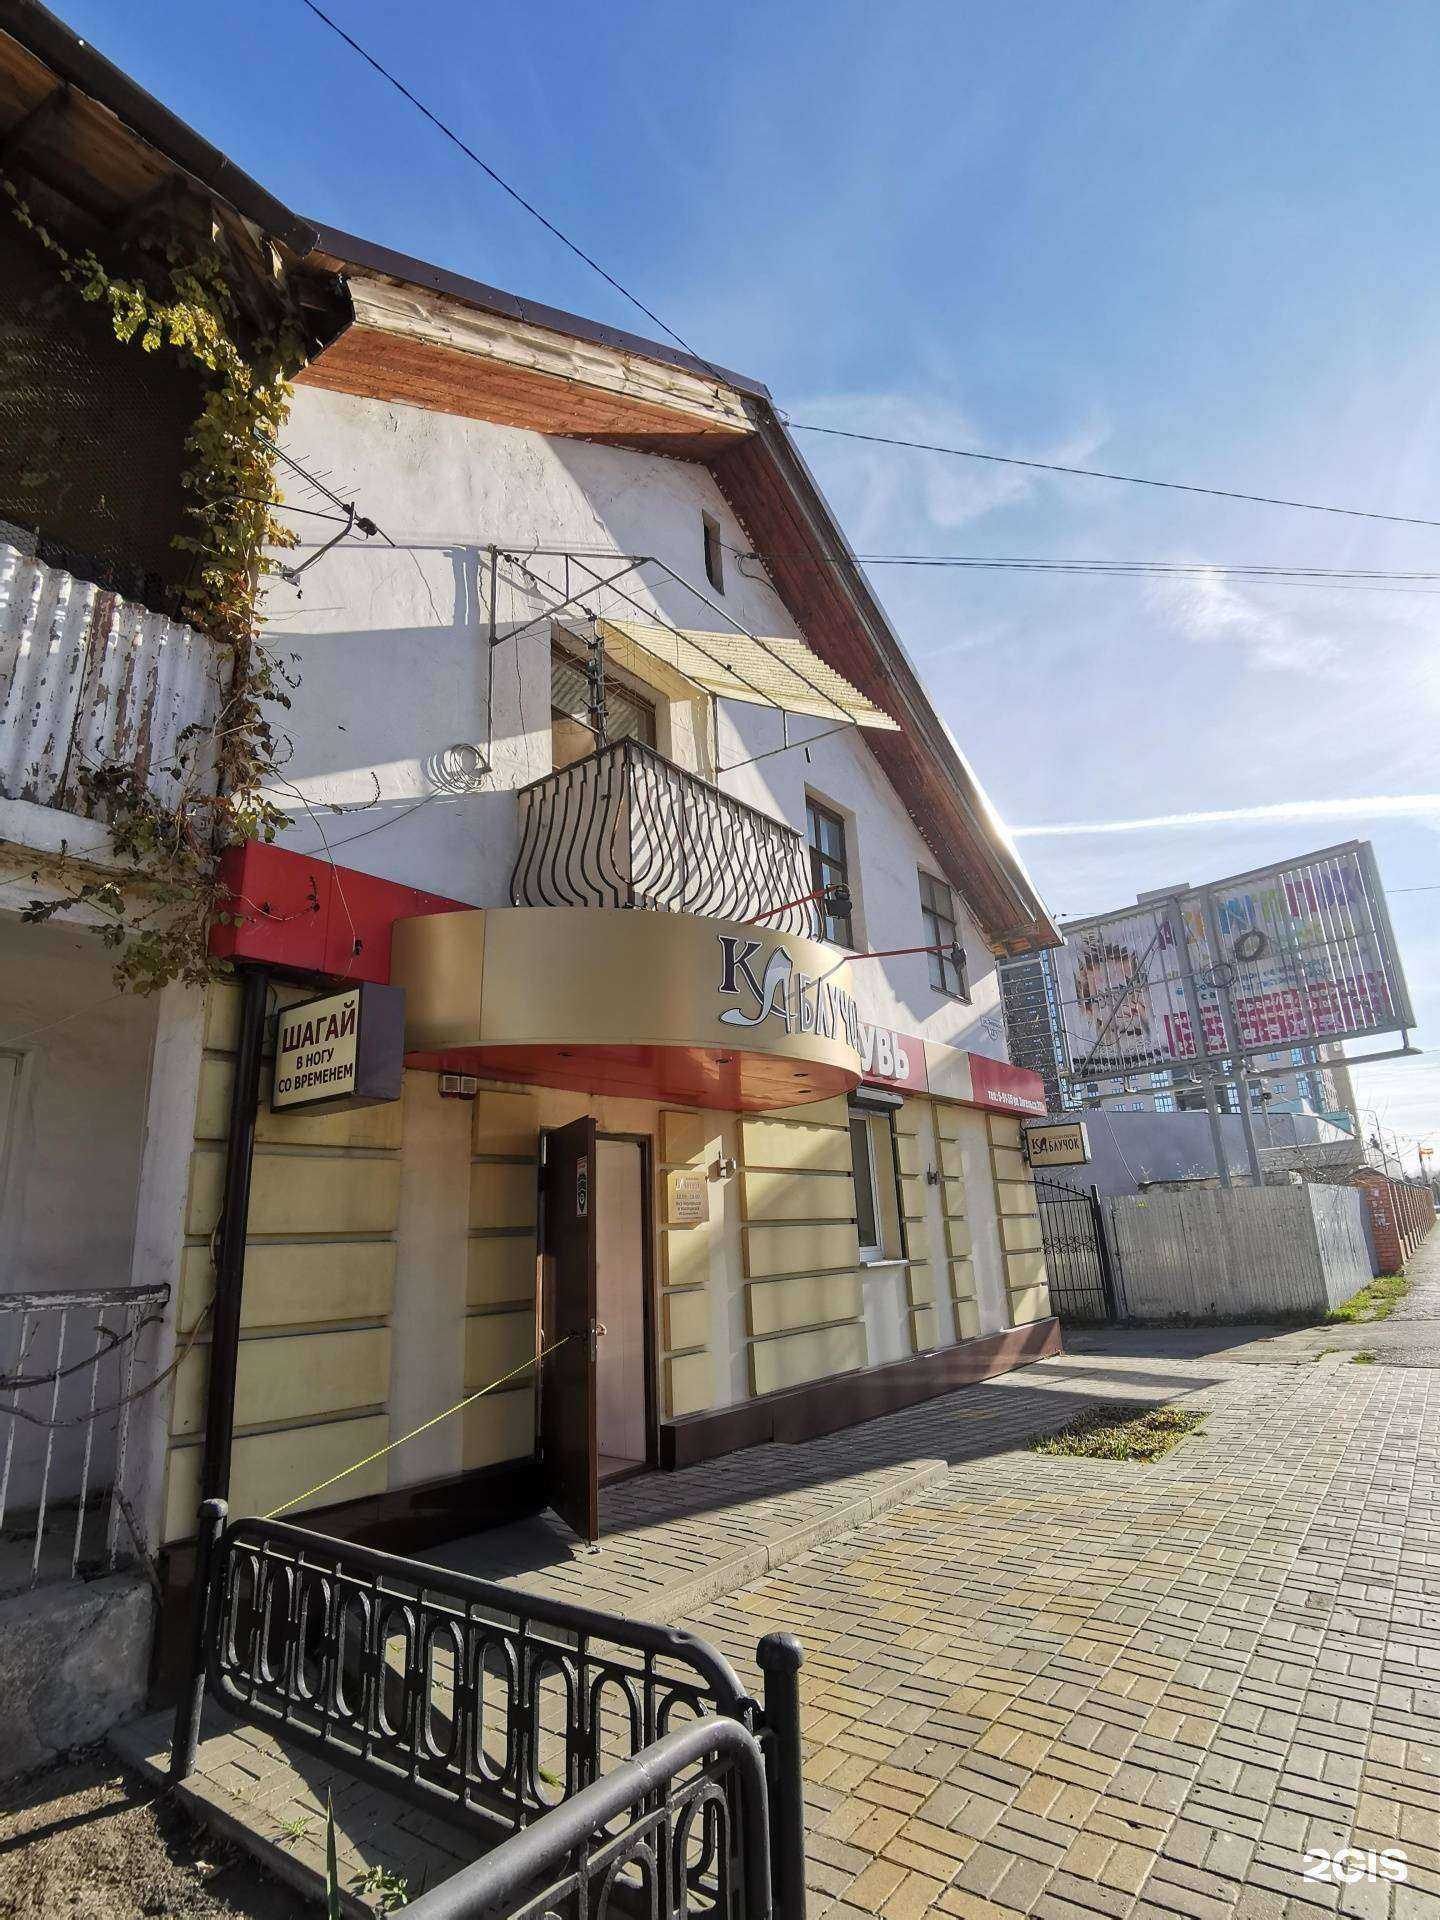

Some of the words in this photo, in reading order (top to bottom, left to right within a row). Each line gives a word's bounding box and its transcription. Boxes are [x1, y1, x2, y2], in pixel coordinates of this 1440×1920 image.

[282, 1000, 355, 1053] ШАГАЙ
[296, 1055, 303, 1070] В
[305, 1047, 334, 1067] НОГУ
[278, 1077, 291, 1093] СО
[294, 1063, 354, 1090] ВРЕМЕНЕМ
